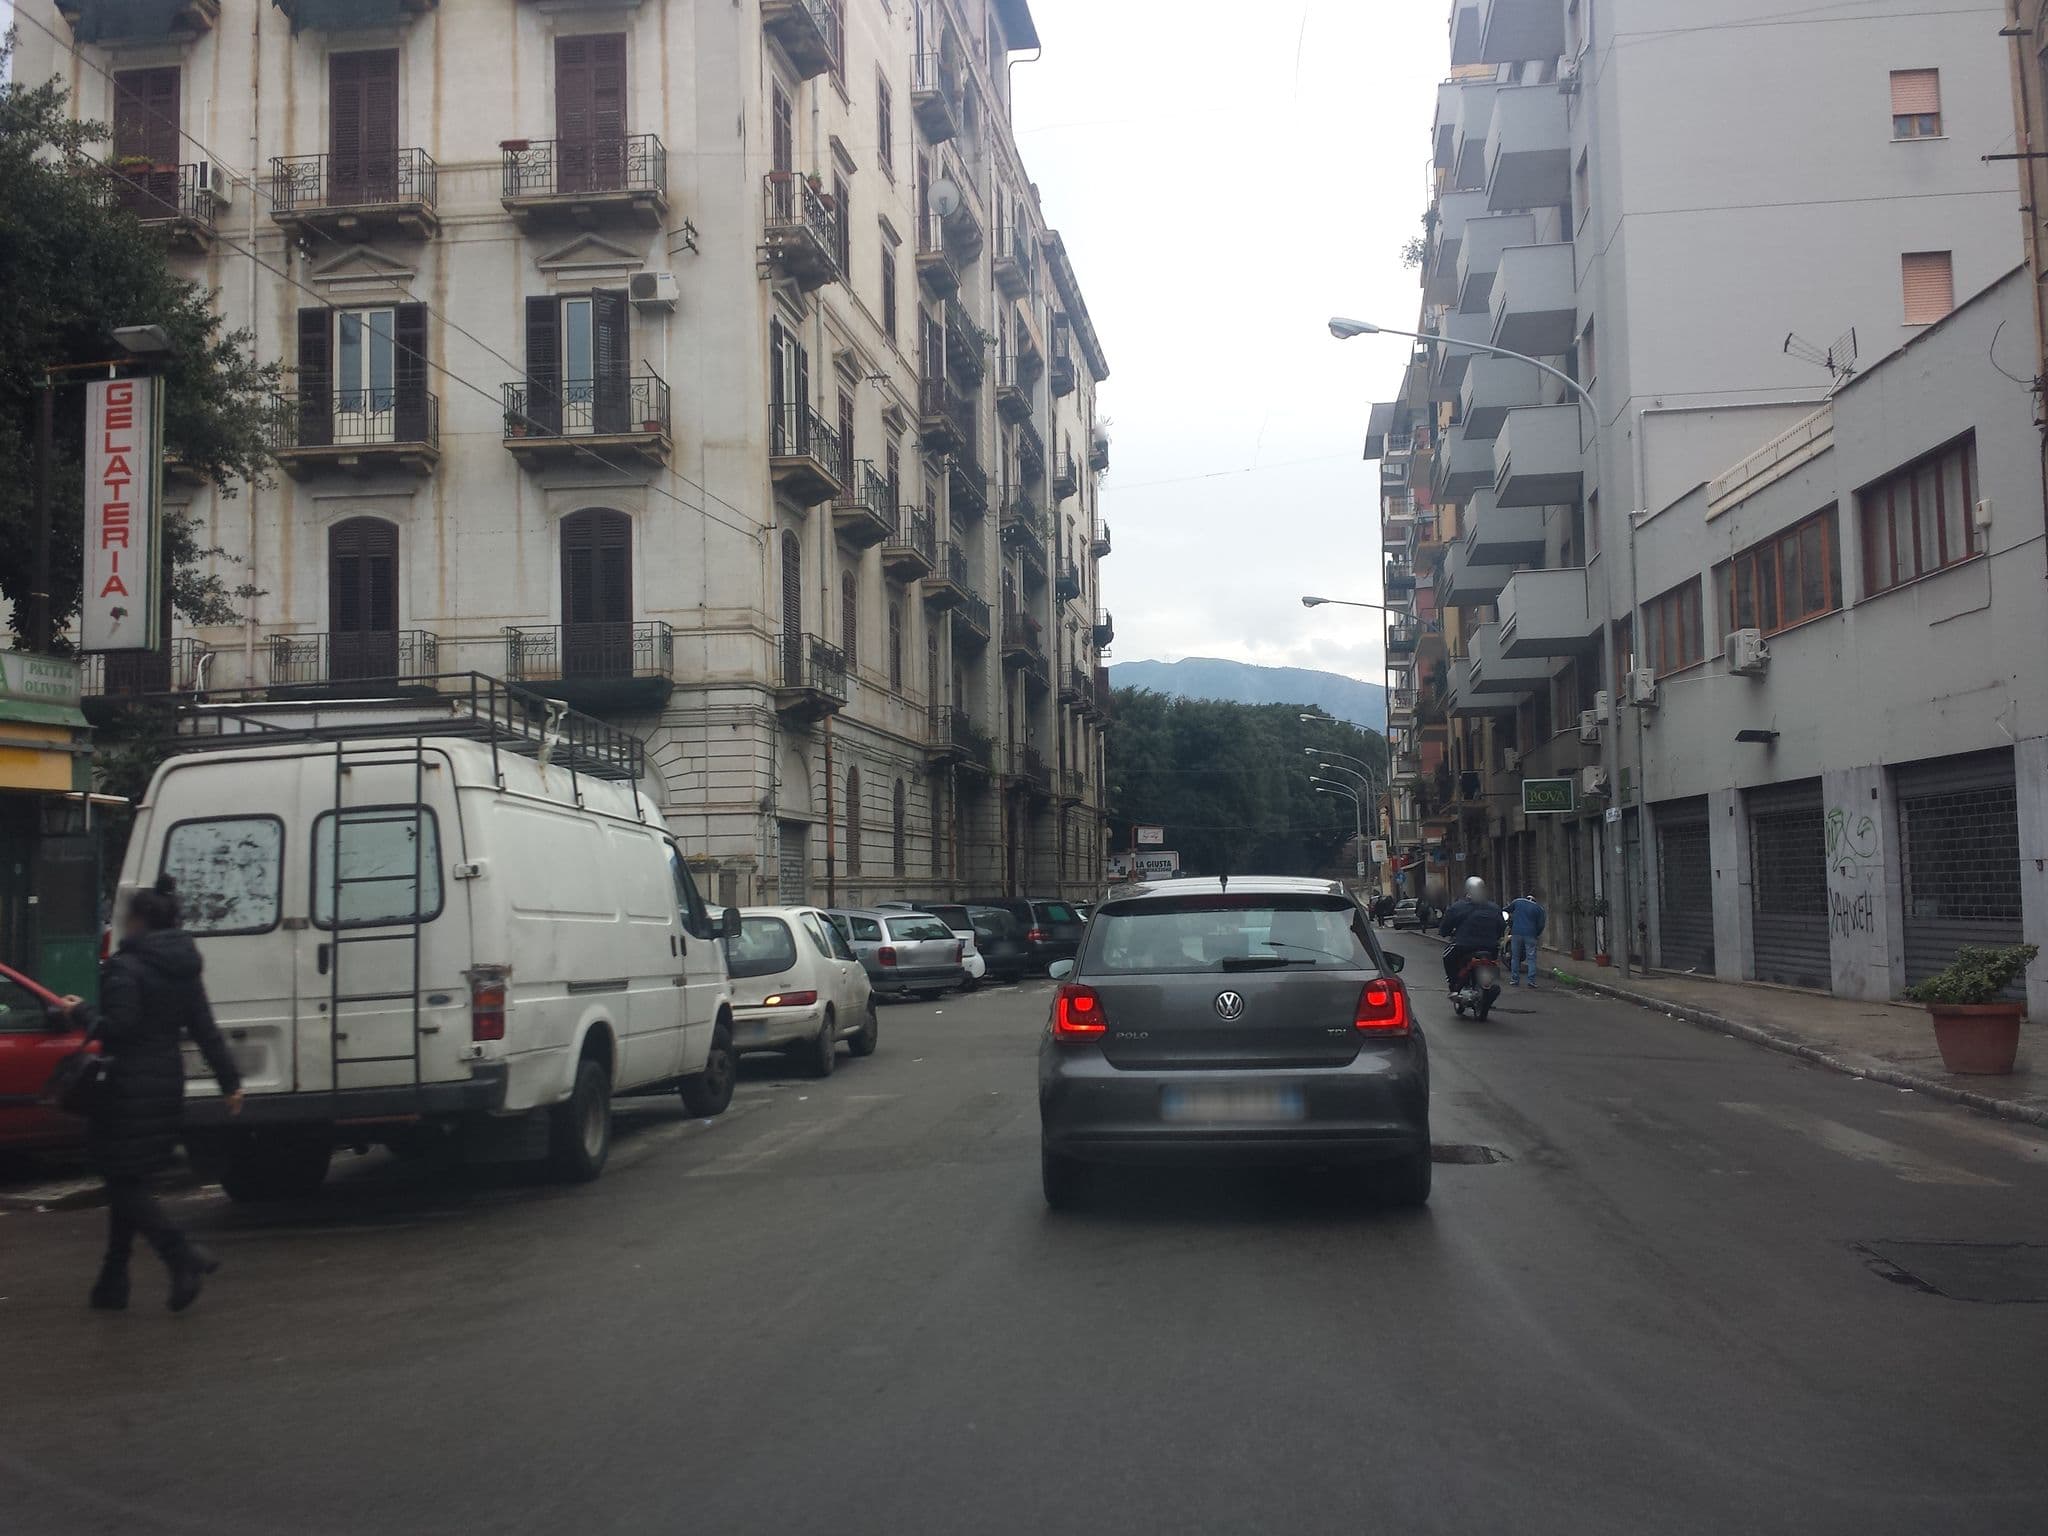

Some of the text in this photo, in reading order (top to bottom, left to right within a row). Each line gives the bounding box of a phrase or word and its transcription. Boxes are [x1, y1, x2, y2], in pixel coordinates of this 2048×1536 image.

[100, 382, 133, 598] GELATERIA
[1136, 860, 1172, 869] LA GIUSTA
[1829, 887, 1874, 939] YAHWEH
[1116, 1031, 1149, 1040] POLO
